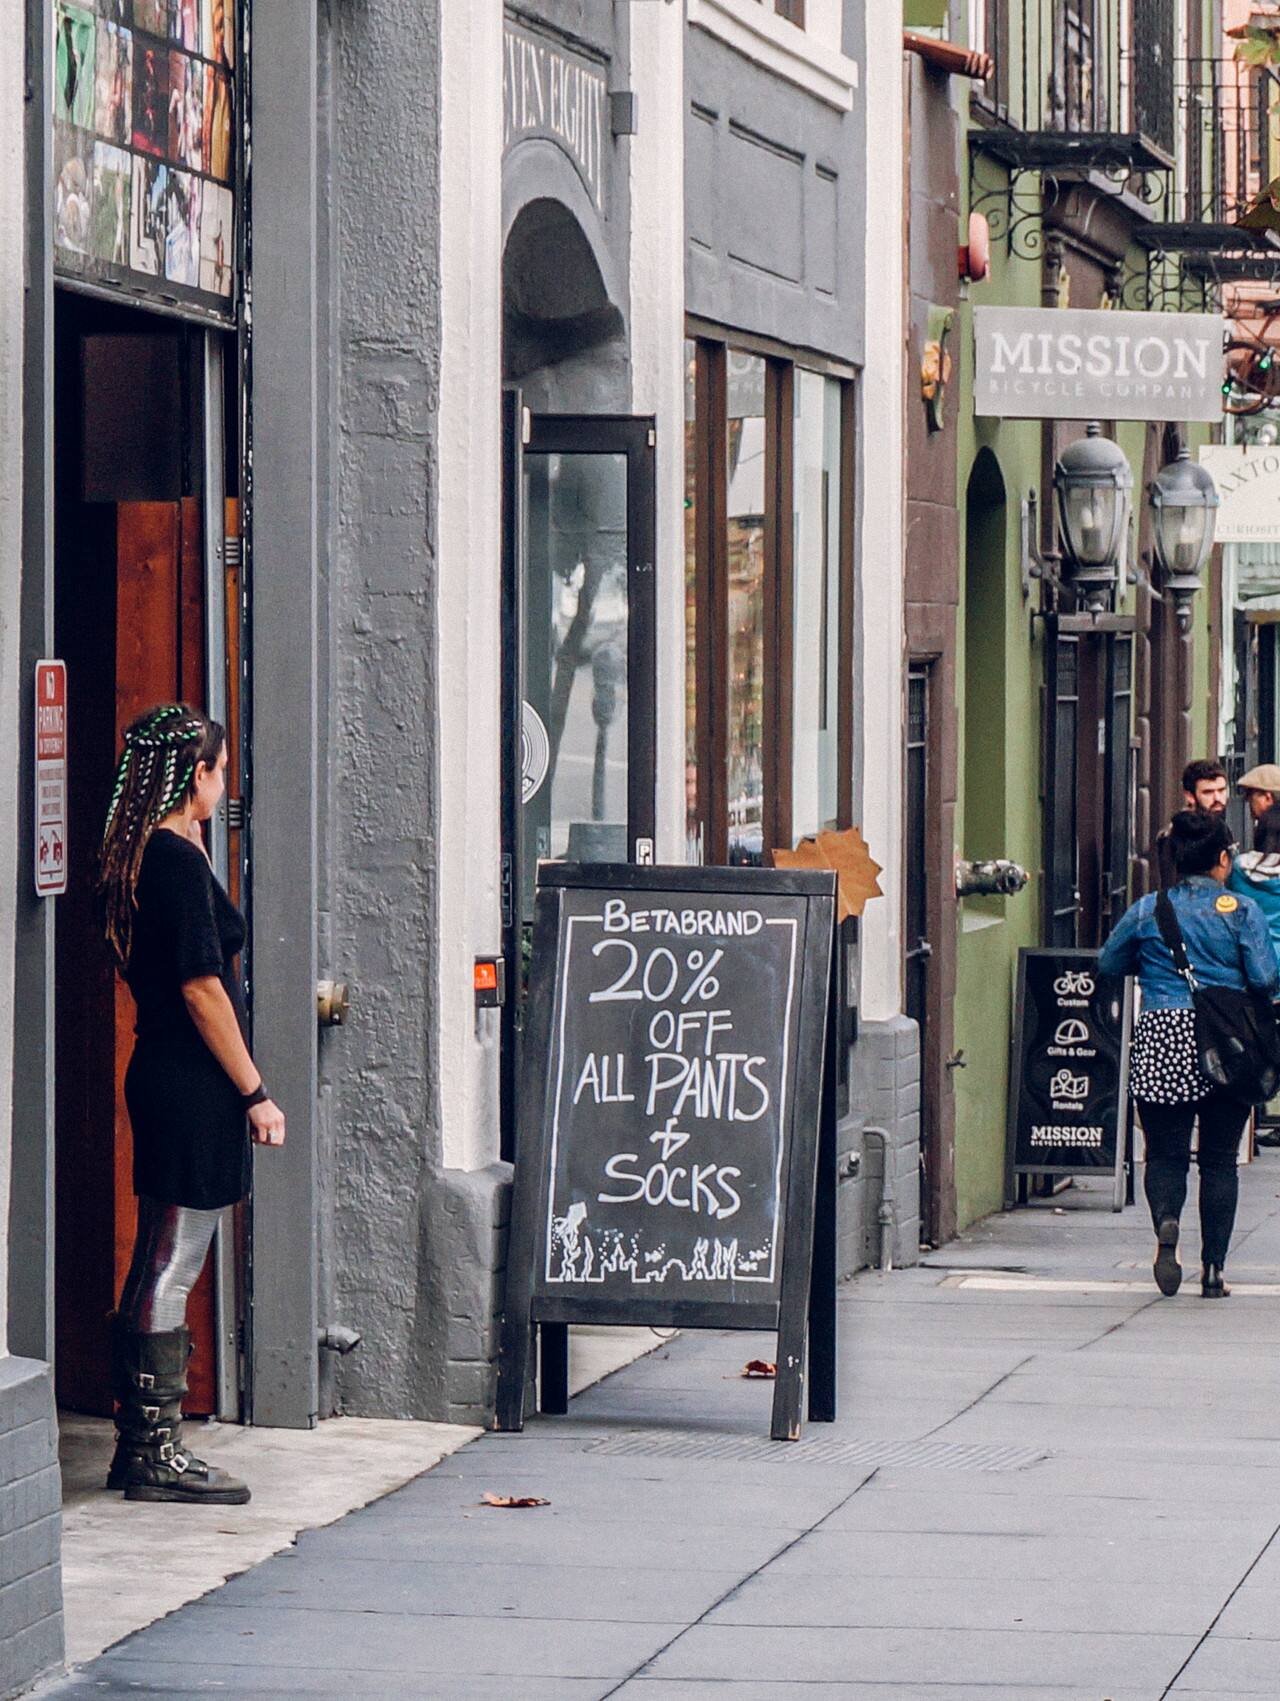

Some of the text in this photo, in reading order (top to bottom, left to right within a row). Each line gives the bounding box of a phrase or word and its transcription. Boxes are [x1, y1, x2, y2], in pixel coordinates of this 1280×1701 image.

[503, 30, 545, 146] VEN
[990, 332, 1212, 379] MISSION
[989, 379, 1207, 399] BICYCLE COMPANY
[603, 899, 763, 936] BETABRAND
[589, 938, 724, 1004] 20%
[1057, 997, 1089, 1007] Custom
[649, 1009, 733, 1055] OFF
[1047, 1046, 1097, 1057] Gifts & Gear
[573, 1052, 770, 1121] ALL PANTS
[1052, 1100, 1084, 1111] Rentals
[1031, 1126, 1103, 1141] MISSION
[598, 1153, 741, 1220] SOCKS
